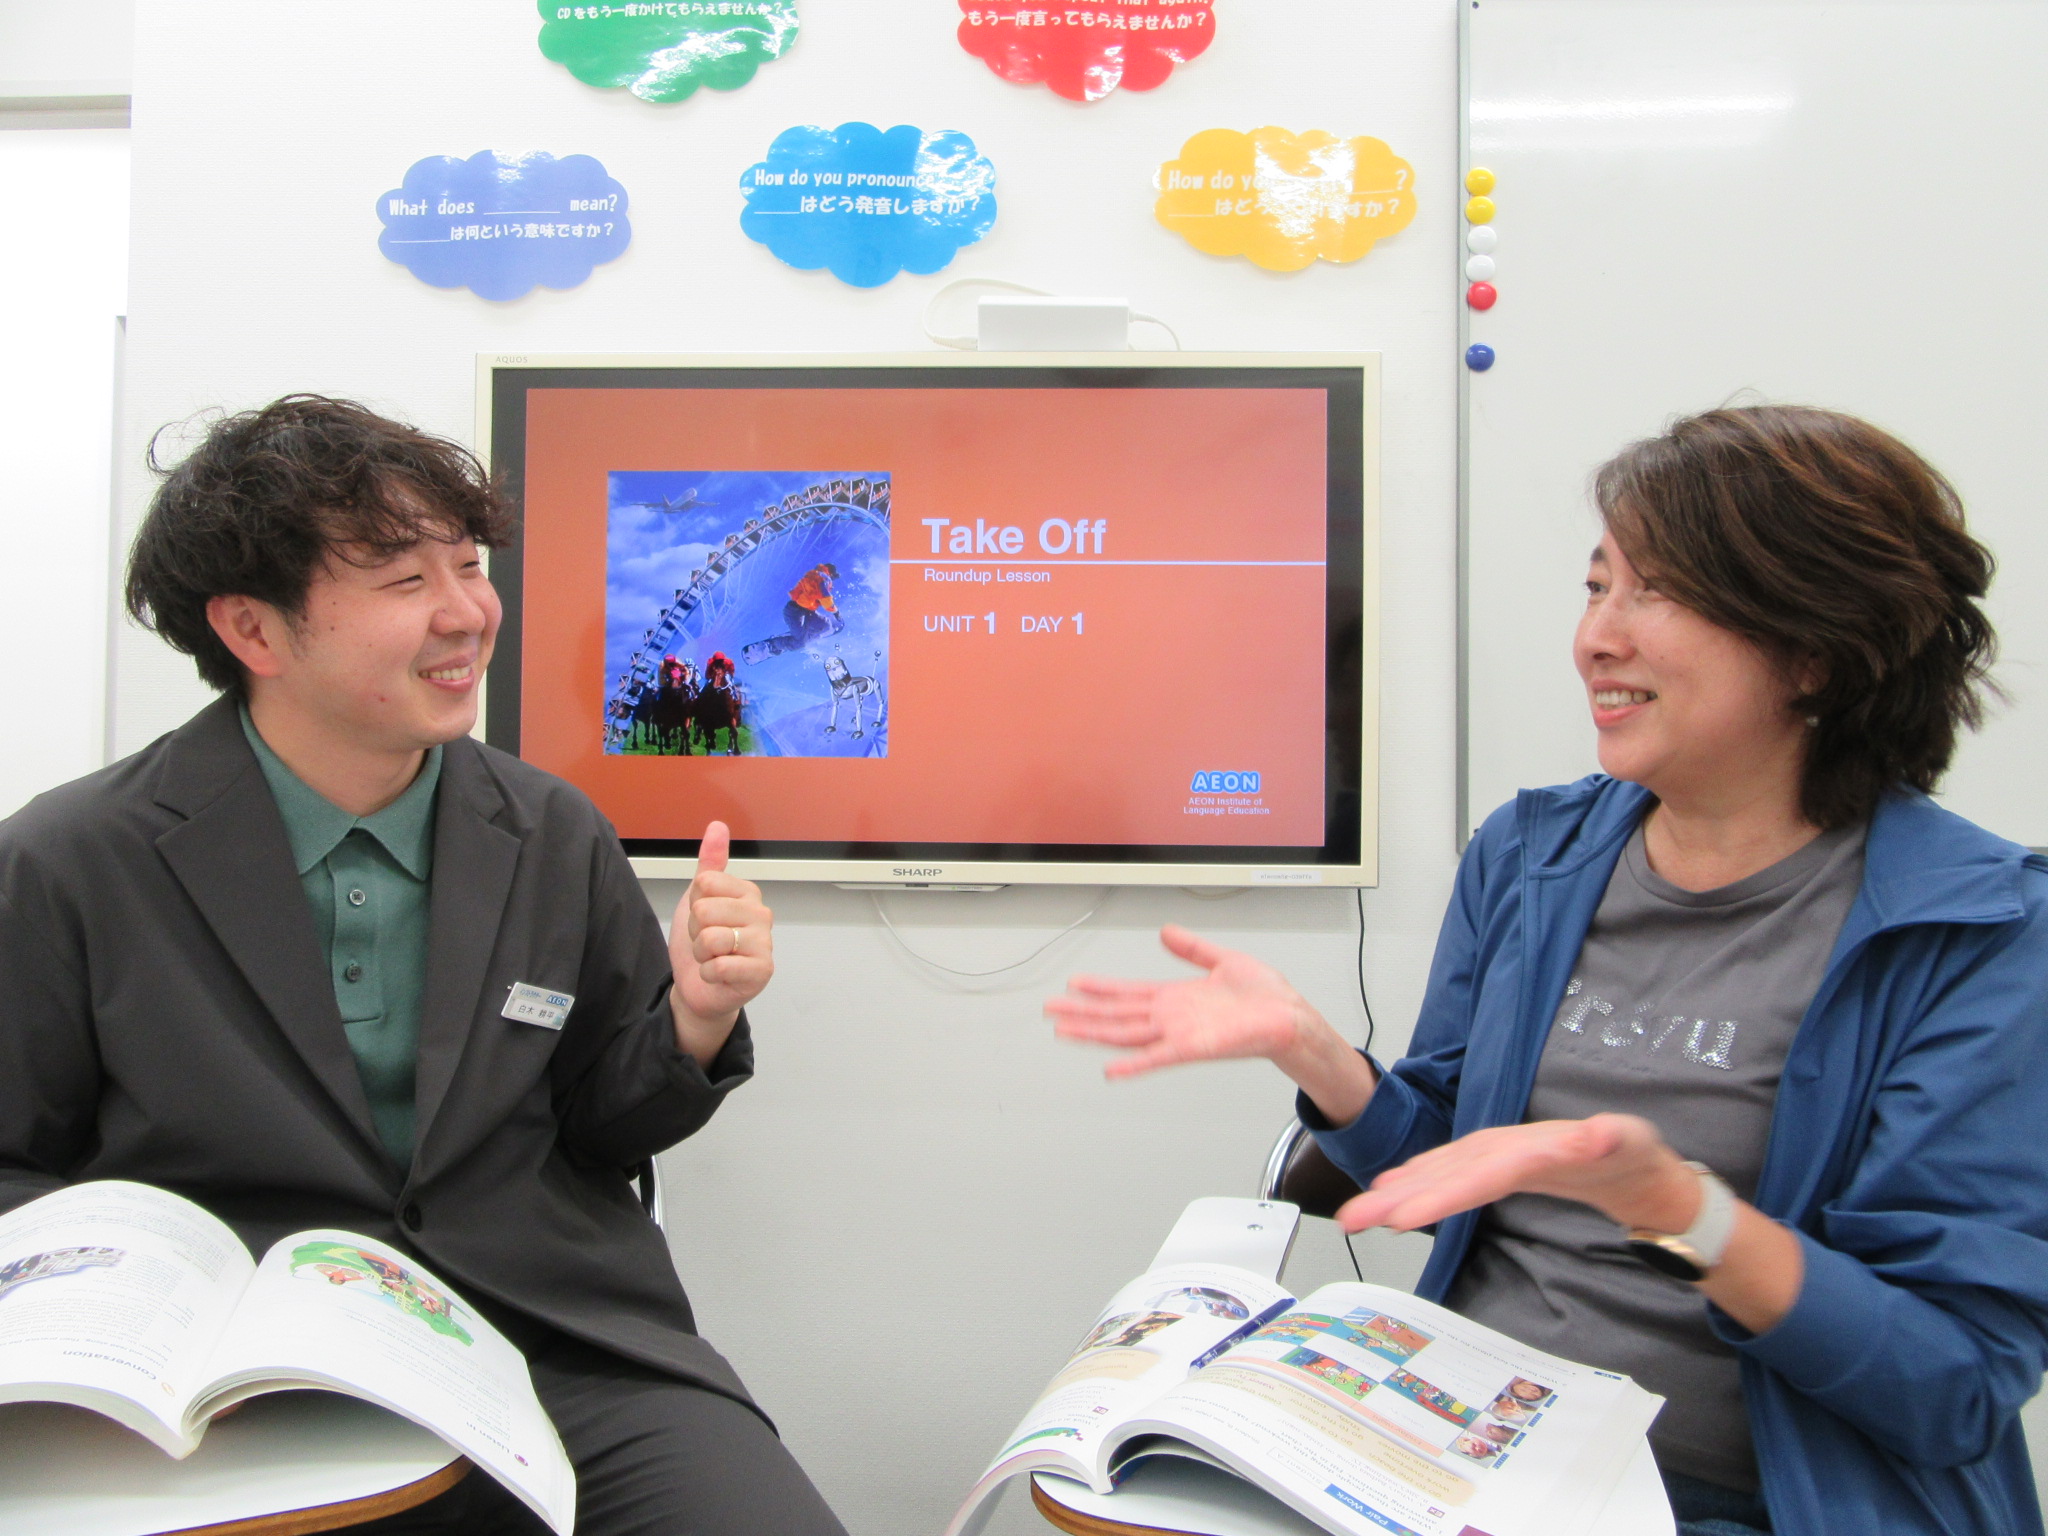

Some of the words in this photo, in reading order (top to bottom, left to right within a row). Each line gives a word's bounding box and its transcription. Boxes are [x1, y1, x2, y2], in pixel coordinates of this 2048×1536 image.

[968, 11, 1206, 30] もう一度言ってもらえませんか？
[755, 169, 784, 186] How
[789, 169, 808, 186] do
[814, 172, 842, 187] you
[847, 172, 934, 188] pronounce
[1168, 170, 1203, 188] How
[1210, 170, 1234, 188] do
[389, 199, 428, 216] What
[438, 199, 474, 214] does
[570, 194, 617, 212] mean?
[922, 518, 1024, 554] Take
[1039, 518, 1106, 554] Off
[924, 568, 992, 585] Roundup
[997, 568, 1050, 582] Lesson
[924, 616, 975, 632] UNIT
[984, 612, 996, 634] 1
[1021, 616, 1063, 632] DAY
[1072, 612, 1084, 634] 1
[1192, 772, 1258, 792] AEON
[1184, 806, 1225, 816] Language
[1228, 806, 1270, 814] Education
[547, 996, 568, 1006] AEON
[62, 1349, 156, 1380] Conversation
[1336, 1491, 1364, 1511] Work
[1365, 1509, 1388, 1525] Pair
